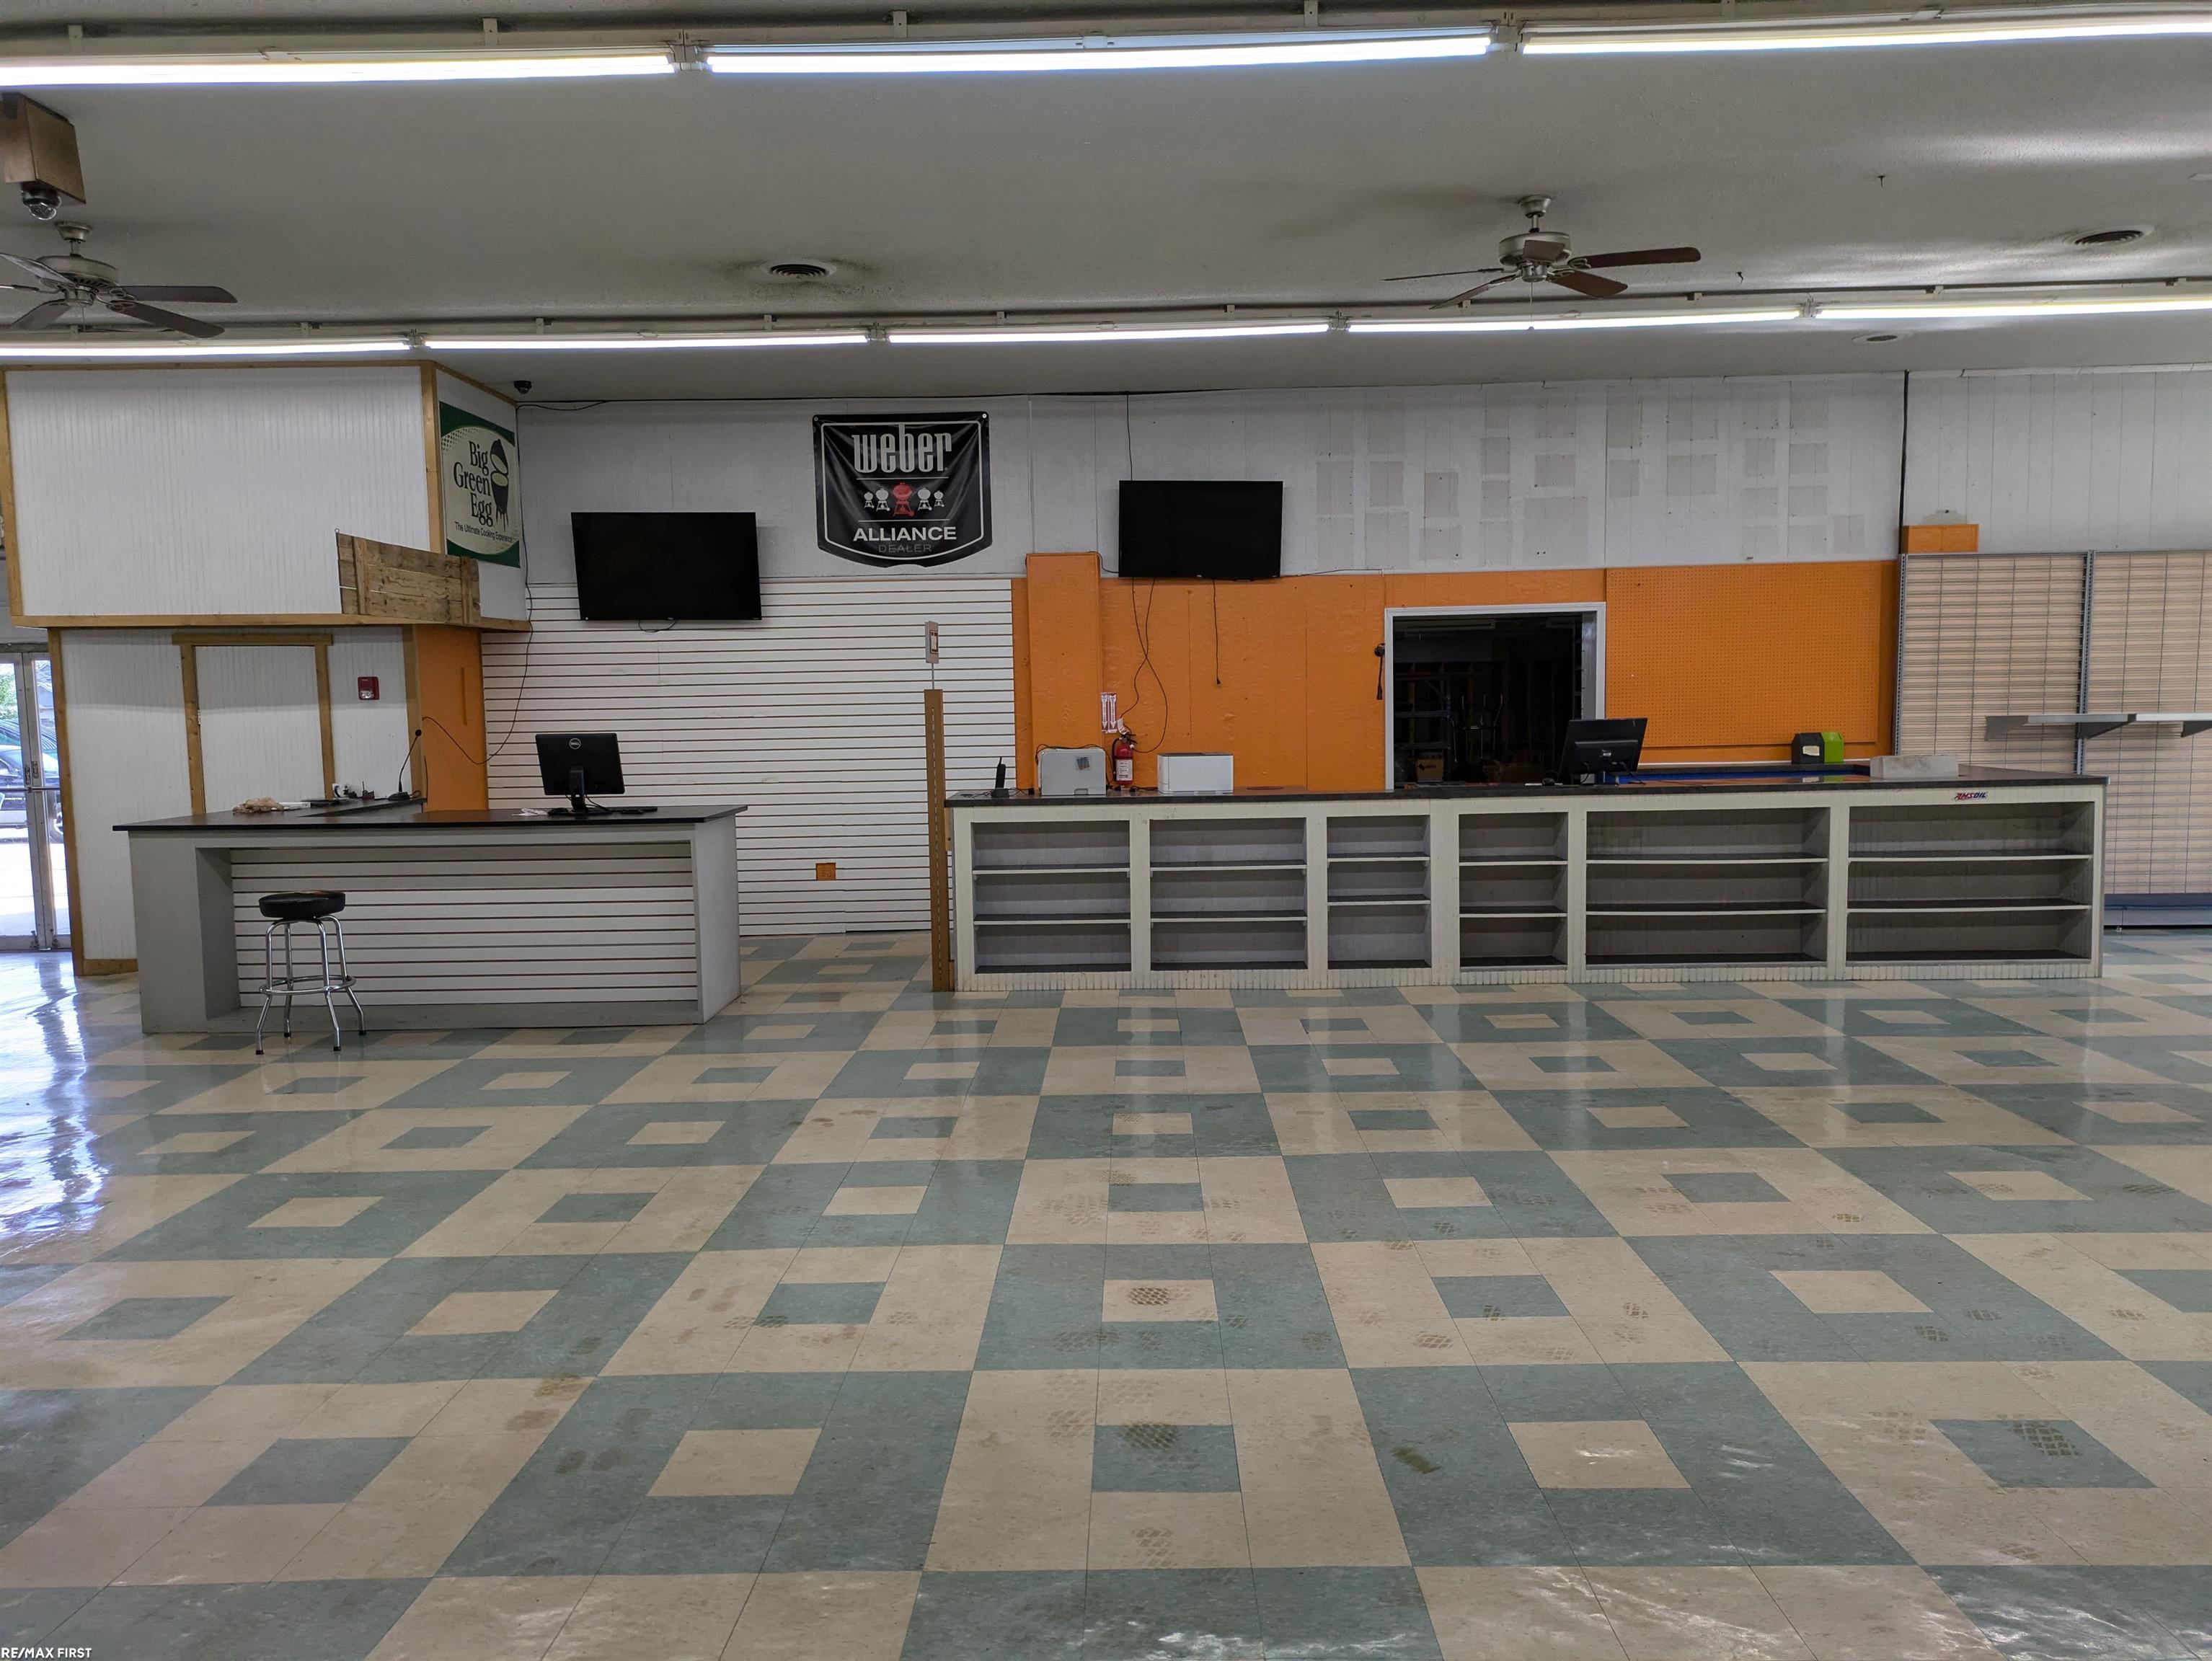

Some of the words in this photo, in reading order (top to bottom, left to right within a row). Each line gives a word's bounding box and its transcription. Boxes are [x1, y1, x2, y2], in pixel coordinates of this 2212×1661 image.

[469, 440, 489, 477] Big
[851, 424, 952, 474] weber
[453, 461, 492, 497] Green
[470, 492, 493, 527] Egg
[454, 521, 464, 531] The
[464, 524, 480, 536] Ultimate
[481, 528, 495, 541] Cooking
[853, 526, 957, 541] ALLIANCE
[878, 544, 932, 553] DEALER
